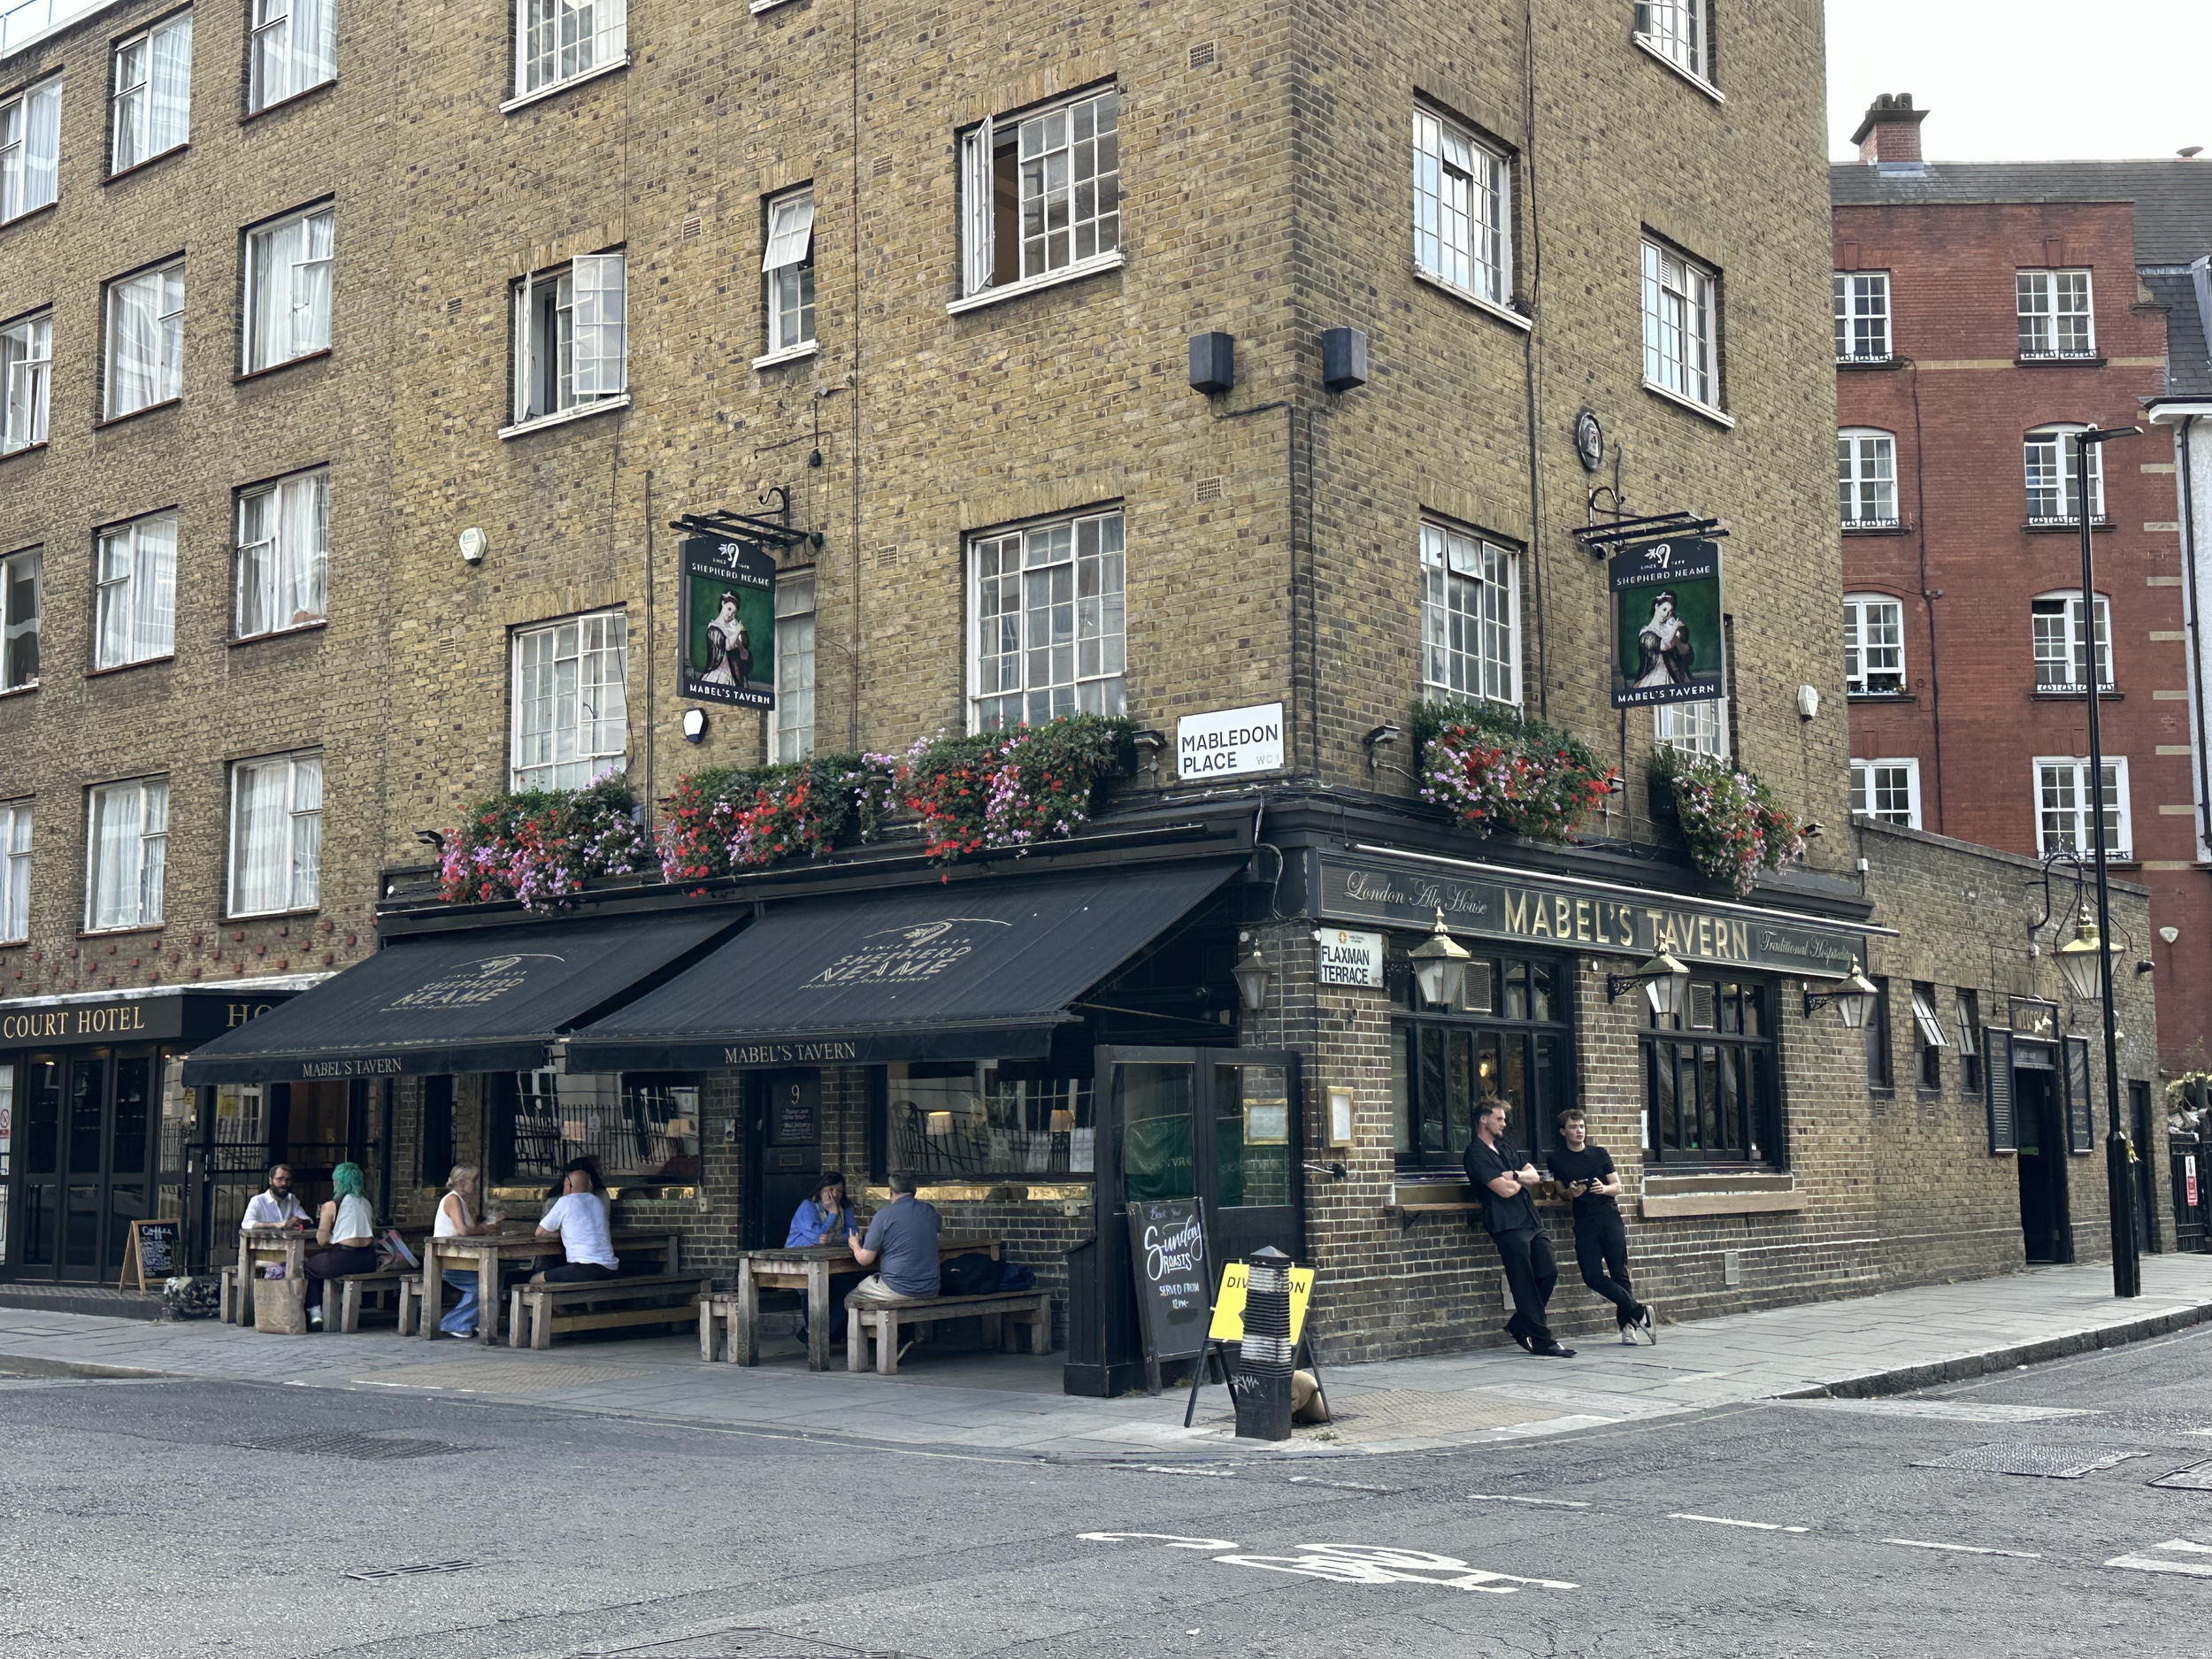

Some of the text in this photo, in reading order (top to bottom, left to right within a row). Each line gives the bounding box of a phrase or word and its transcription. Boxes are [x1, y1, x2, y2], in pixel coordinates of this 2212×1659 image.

[692, 562, 770, 587] SHEPHERD NEAME
[1617, 565, 1710, 586] SHEPHERD NEAME
[689, 683, 771, 704] MABEL'S TAVERN
[1617, 684, 1715, 703] MABEL'S TAVERN
[1181, 723, 1279, 753] MABLEDON
[1183, 751, 1238, 774] PLACE
[1345, 871, 1487, 915] London Ale House
[1504, 887, 1748, 961] MABEL'S TAVERN
[1760, 929, 1809, 956] Traditional
[1321, 945, 1371, 966] FLAXMAN
[809, 957, 957, 982] NEAME
[1322, 964, 1369, 985] TERRACE
[390, 987, 510, 1007] NEAME
[4, 1006, 145, 1040] COURT HOTEL
[725, 1041, 856, 1064] MABEL'S TAVERN
[355, 1057, 403, 1075] TAVERN
[791, 1084, 800, 1105] 9
[1144, 1215, 1204, 1280] Sunday
[1163, 1252, 1193, 1274] ROASTS
